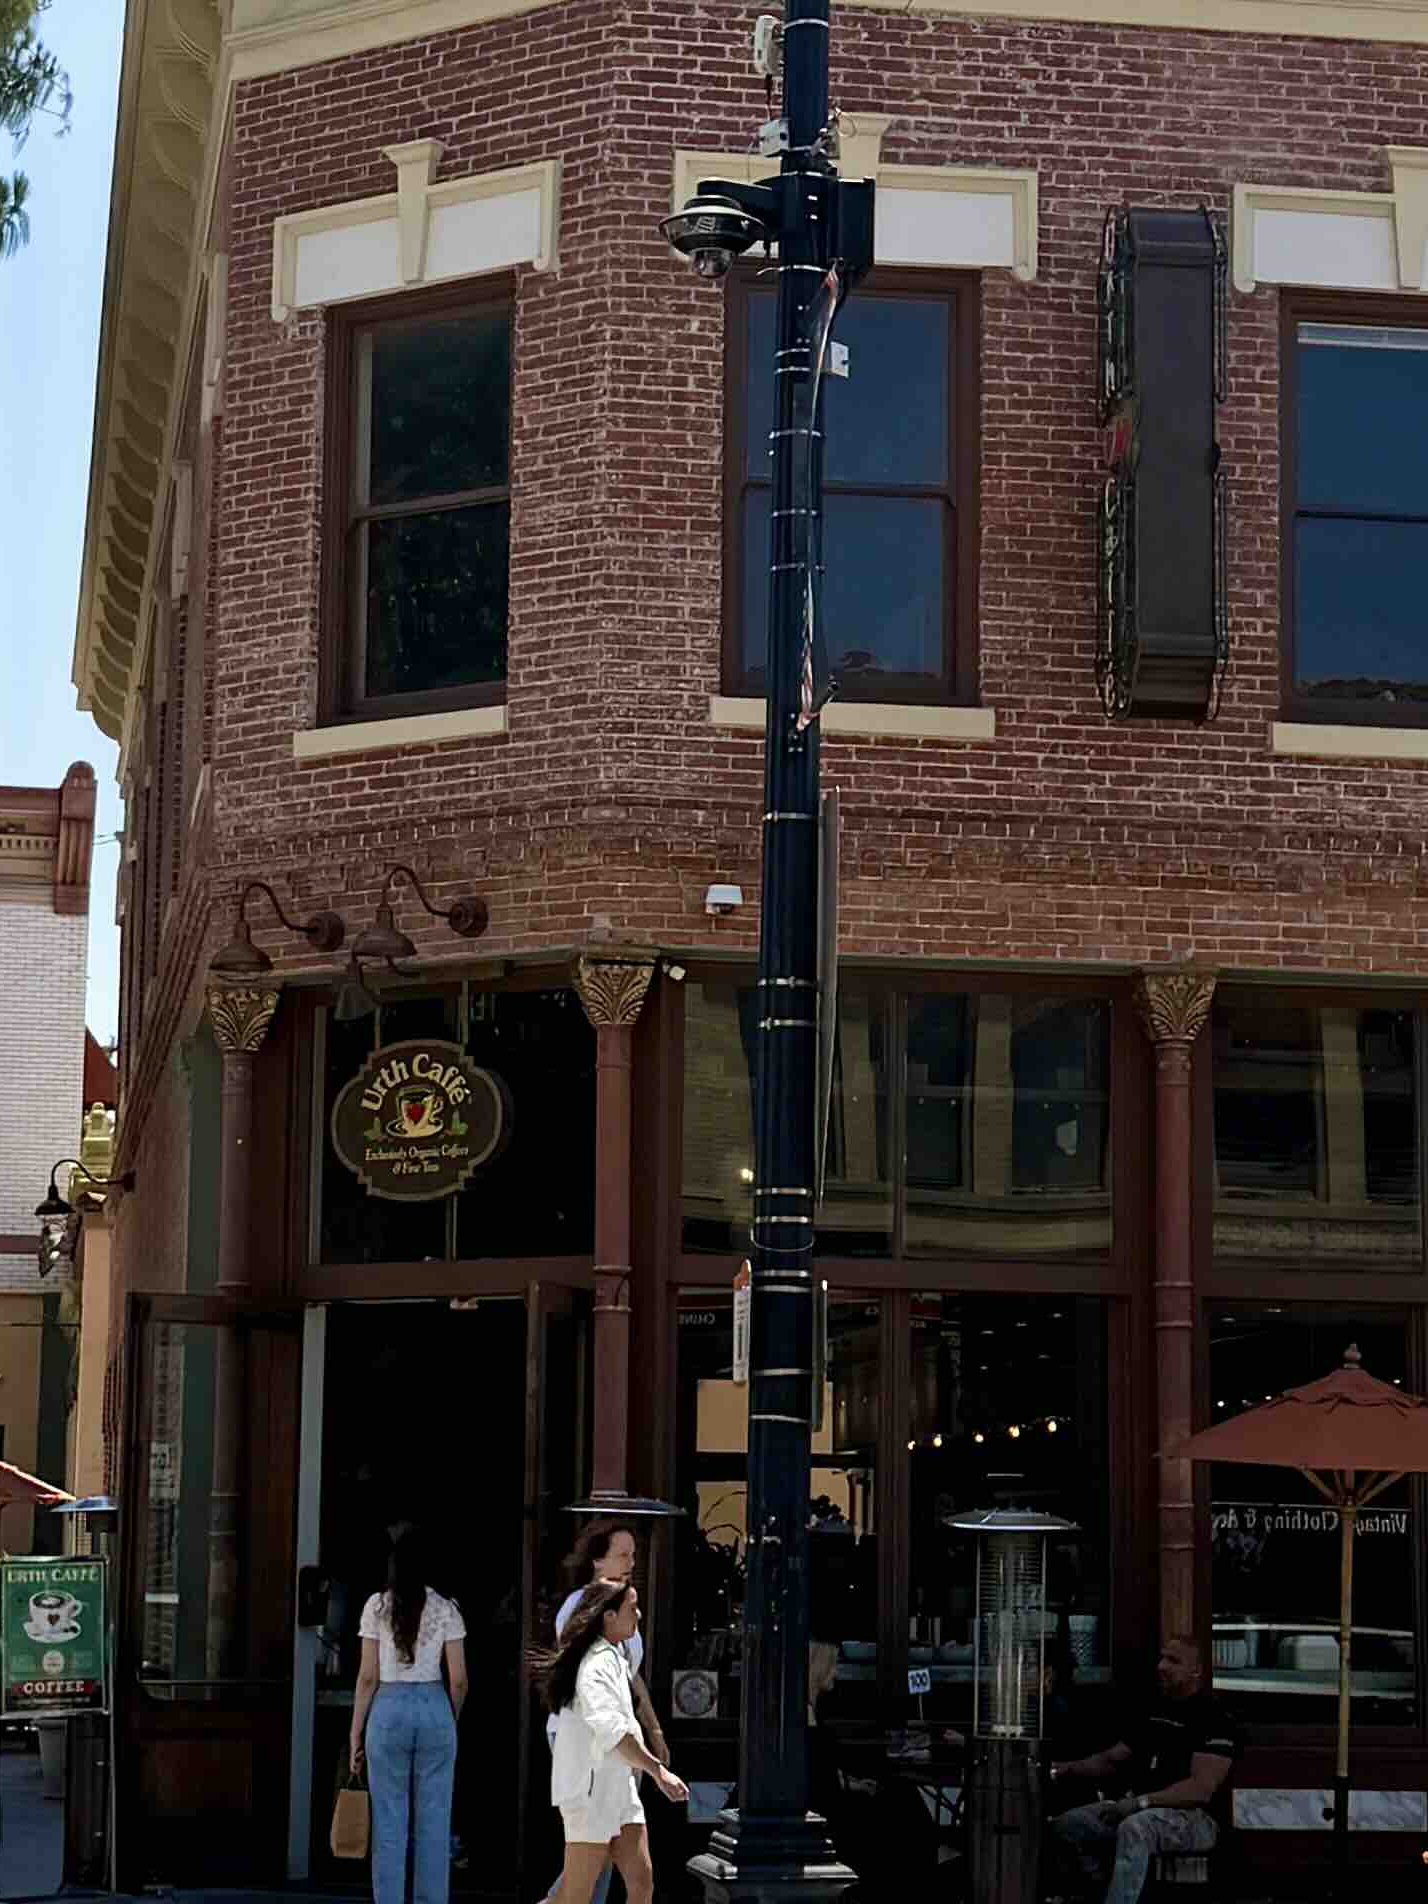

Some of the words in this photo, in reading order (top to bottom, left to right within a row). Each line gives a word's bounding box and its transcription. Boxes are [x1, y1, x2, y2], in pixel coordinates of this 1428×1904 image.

[361, 1059, 410, 1112] Urth
[412, 1053, 471, 1106] Caffé
[909, 1672, 930, 1687] 100
[23, 1680, 86, 1695] COFFEE
